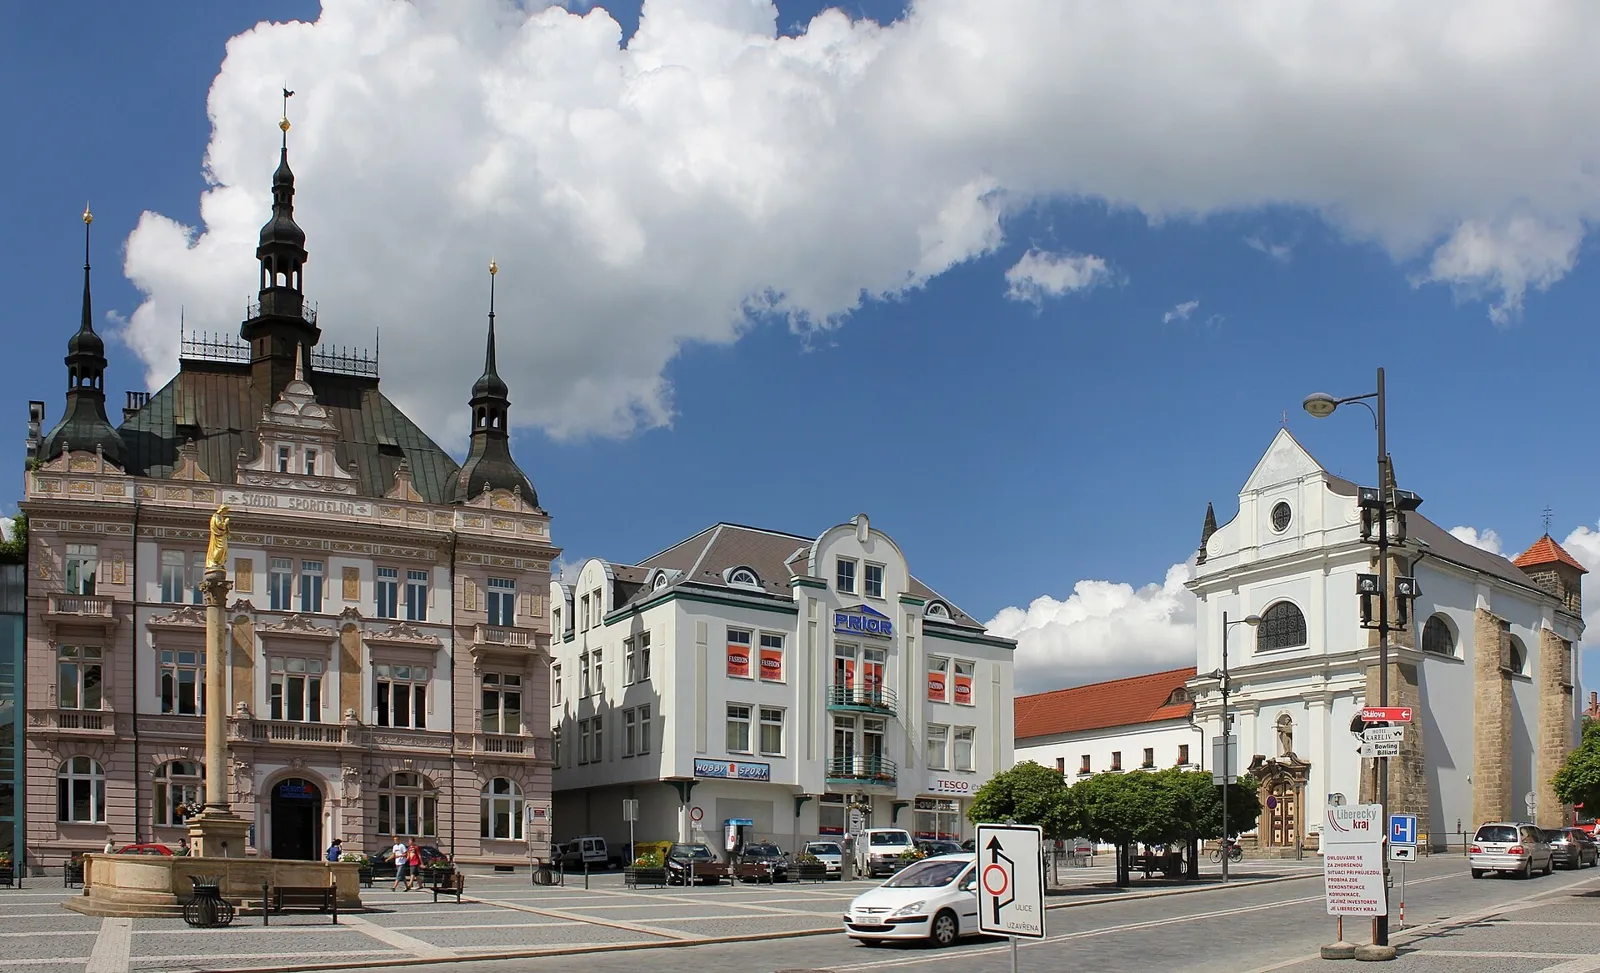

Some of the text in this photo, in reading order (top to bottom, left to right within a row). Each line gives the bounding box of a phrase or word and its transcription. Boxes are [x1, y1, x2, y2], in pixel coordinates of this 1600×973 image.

[834, 613, 893, 635] PRIOR
[696, 763, 767, 776] HOBBY SPORT
[937, 779, 969, 790] TESCO
[1336, 808, 1377, 820] Liberecký
[1352, 819, 1369, 831] kraj
[1015, 904, 1033, 912] ULICE
[1007, 921, 1039, 932] UZAVŘENA
